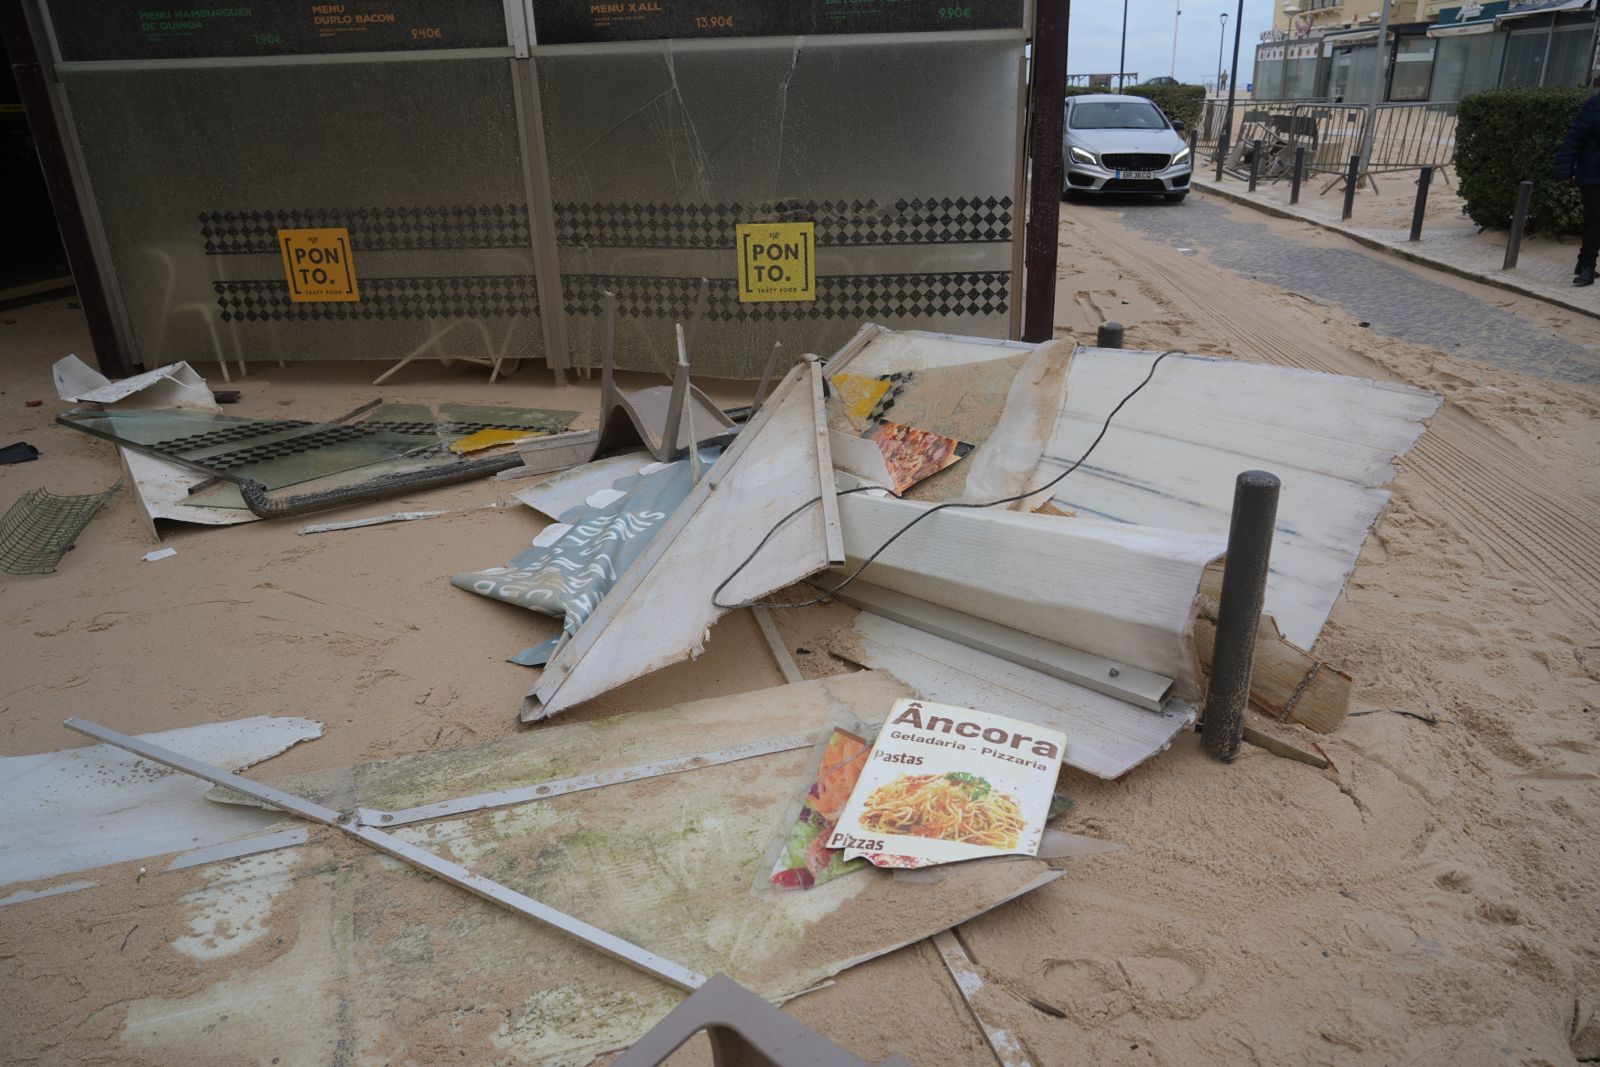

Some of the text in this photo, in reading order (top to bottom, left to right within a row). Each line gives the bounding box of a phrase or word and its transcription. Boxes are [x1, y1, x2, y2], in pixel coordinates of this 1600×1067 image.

[138, 8, 252, 20] MENU HAMBURGUER
[312, 5, 345, 14] MENU
[590, 3, 624, 13] MENU
[142, 21, 204, 31] DE QUINOA
[314, 13, 395, 25] DUPLO BACON
[696, 16, 734, 28] 13.90€
[294, 248, 339, 264] PON
[753, 243, 799, 261] PON
[299, 268, 335, 285] TO.
[754, 265, 791, 282] TO.
[891, 702, 1058, 760] Âncora
[874, 749, 924, 766] Pastas
[890, 731, 966, 751] Geladaria
[980, 747, 1047, 771] Pizzaria
[831, 833, 885, 851] Pizzas
